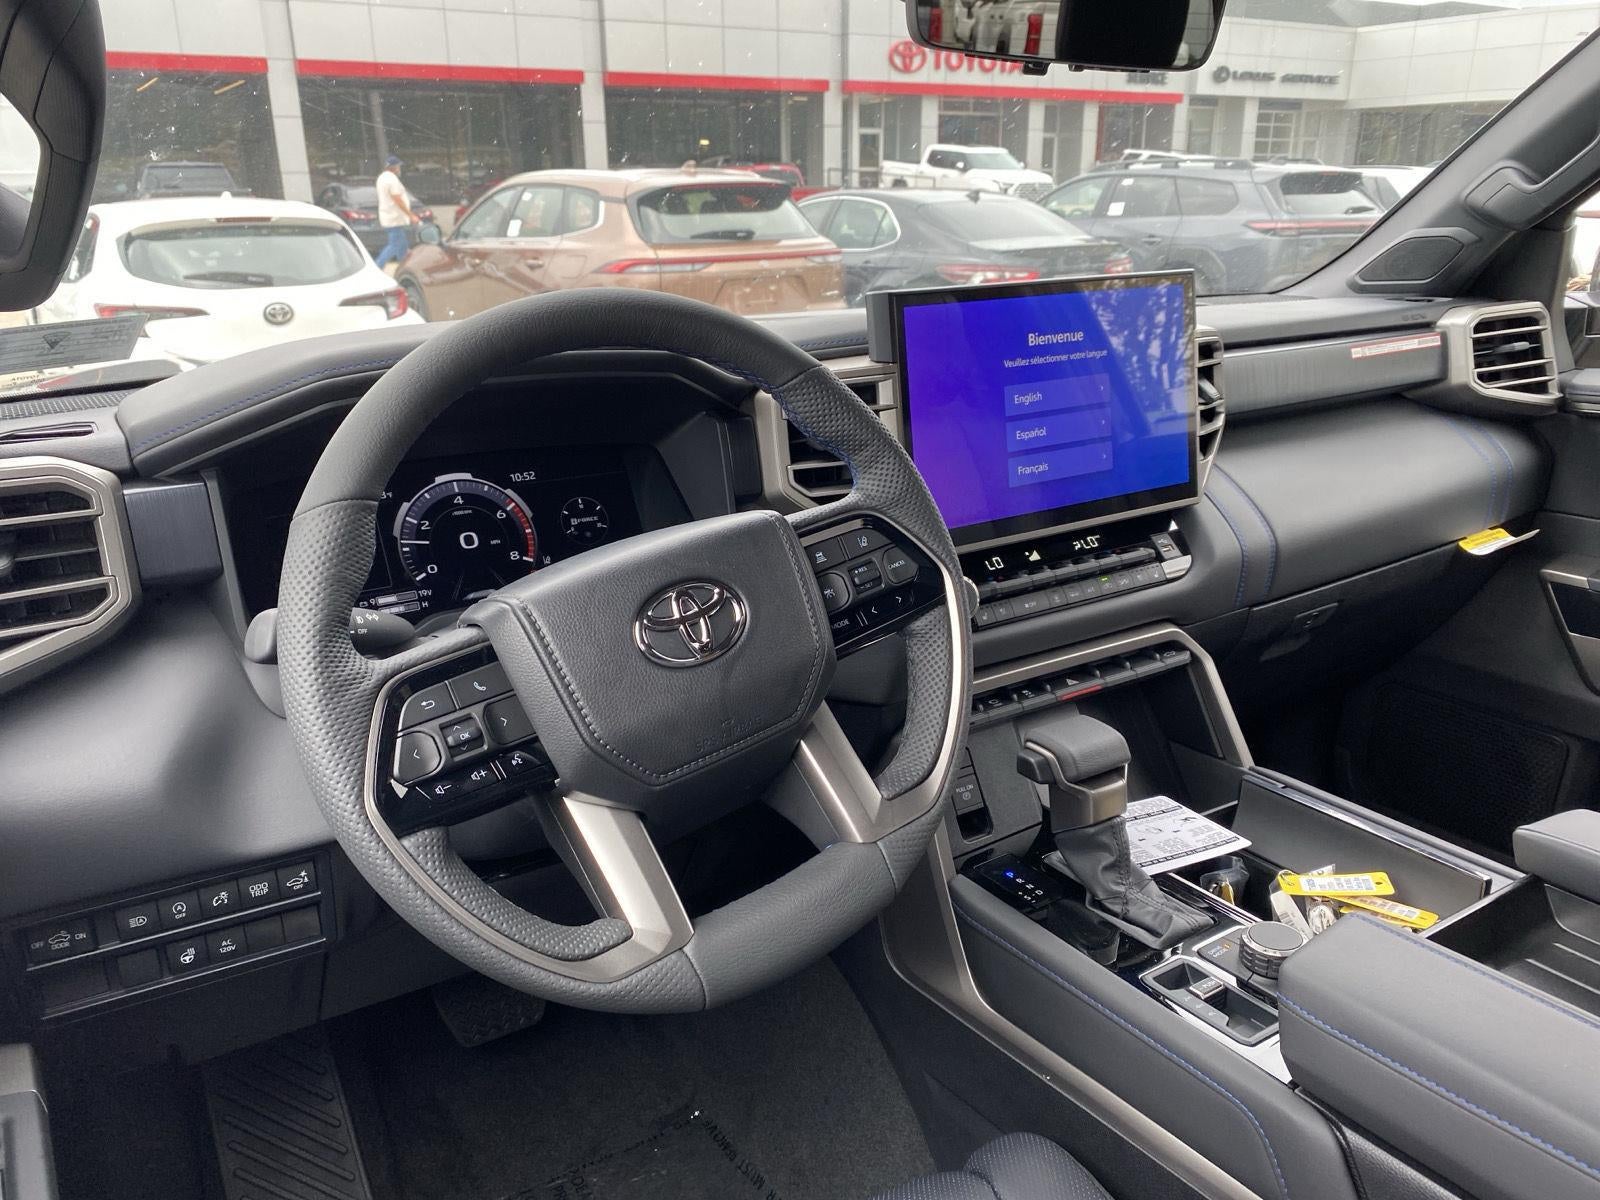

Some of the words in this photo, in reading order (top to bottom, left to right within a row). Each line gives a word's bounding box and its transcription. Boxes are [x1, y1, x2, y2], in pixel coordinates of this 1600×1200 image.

[1027, 330, 1085, 346] Bienvenue
[1003, 358, 1030, 369] Veuillez
[1029, 352, 1069, 366] sélectionner
[1069, 350, 1086, 361] votre
[1086, 349, 1108, 360] langue
[1014, 391, 1043, 406] English
[1015, 426, 1047, 441] Español
[1017, 461, 1049, 476] Français
[510, 471, 537, 483] 10:52
[453, 495, 464, 505] 4
[496, 509, 506, 519] 6
[420, 520, 431, 530] 2
[459, 531, 480, 550] 0
[510, 550, 520, 561] 8
[985, 556, 1004, 571] LO
[427, 564, 438, 574] 0
[418, 589, 432, 597] 19V
[422, 600, 429, 608] H
[831, 618, 850, 630] MODE
[459, 731, 471, 741] OK
[248, 882, 269, 893] ODO
[250, 889, 269, 898] TRIP
[74, 932, 87, 940] ON
[221, 939, 233, 947] AC
[219, 944, 237, 954] 120V
